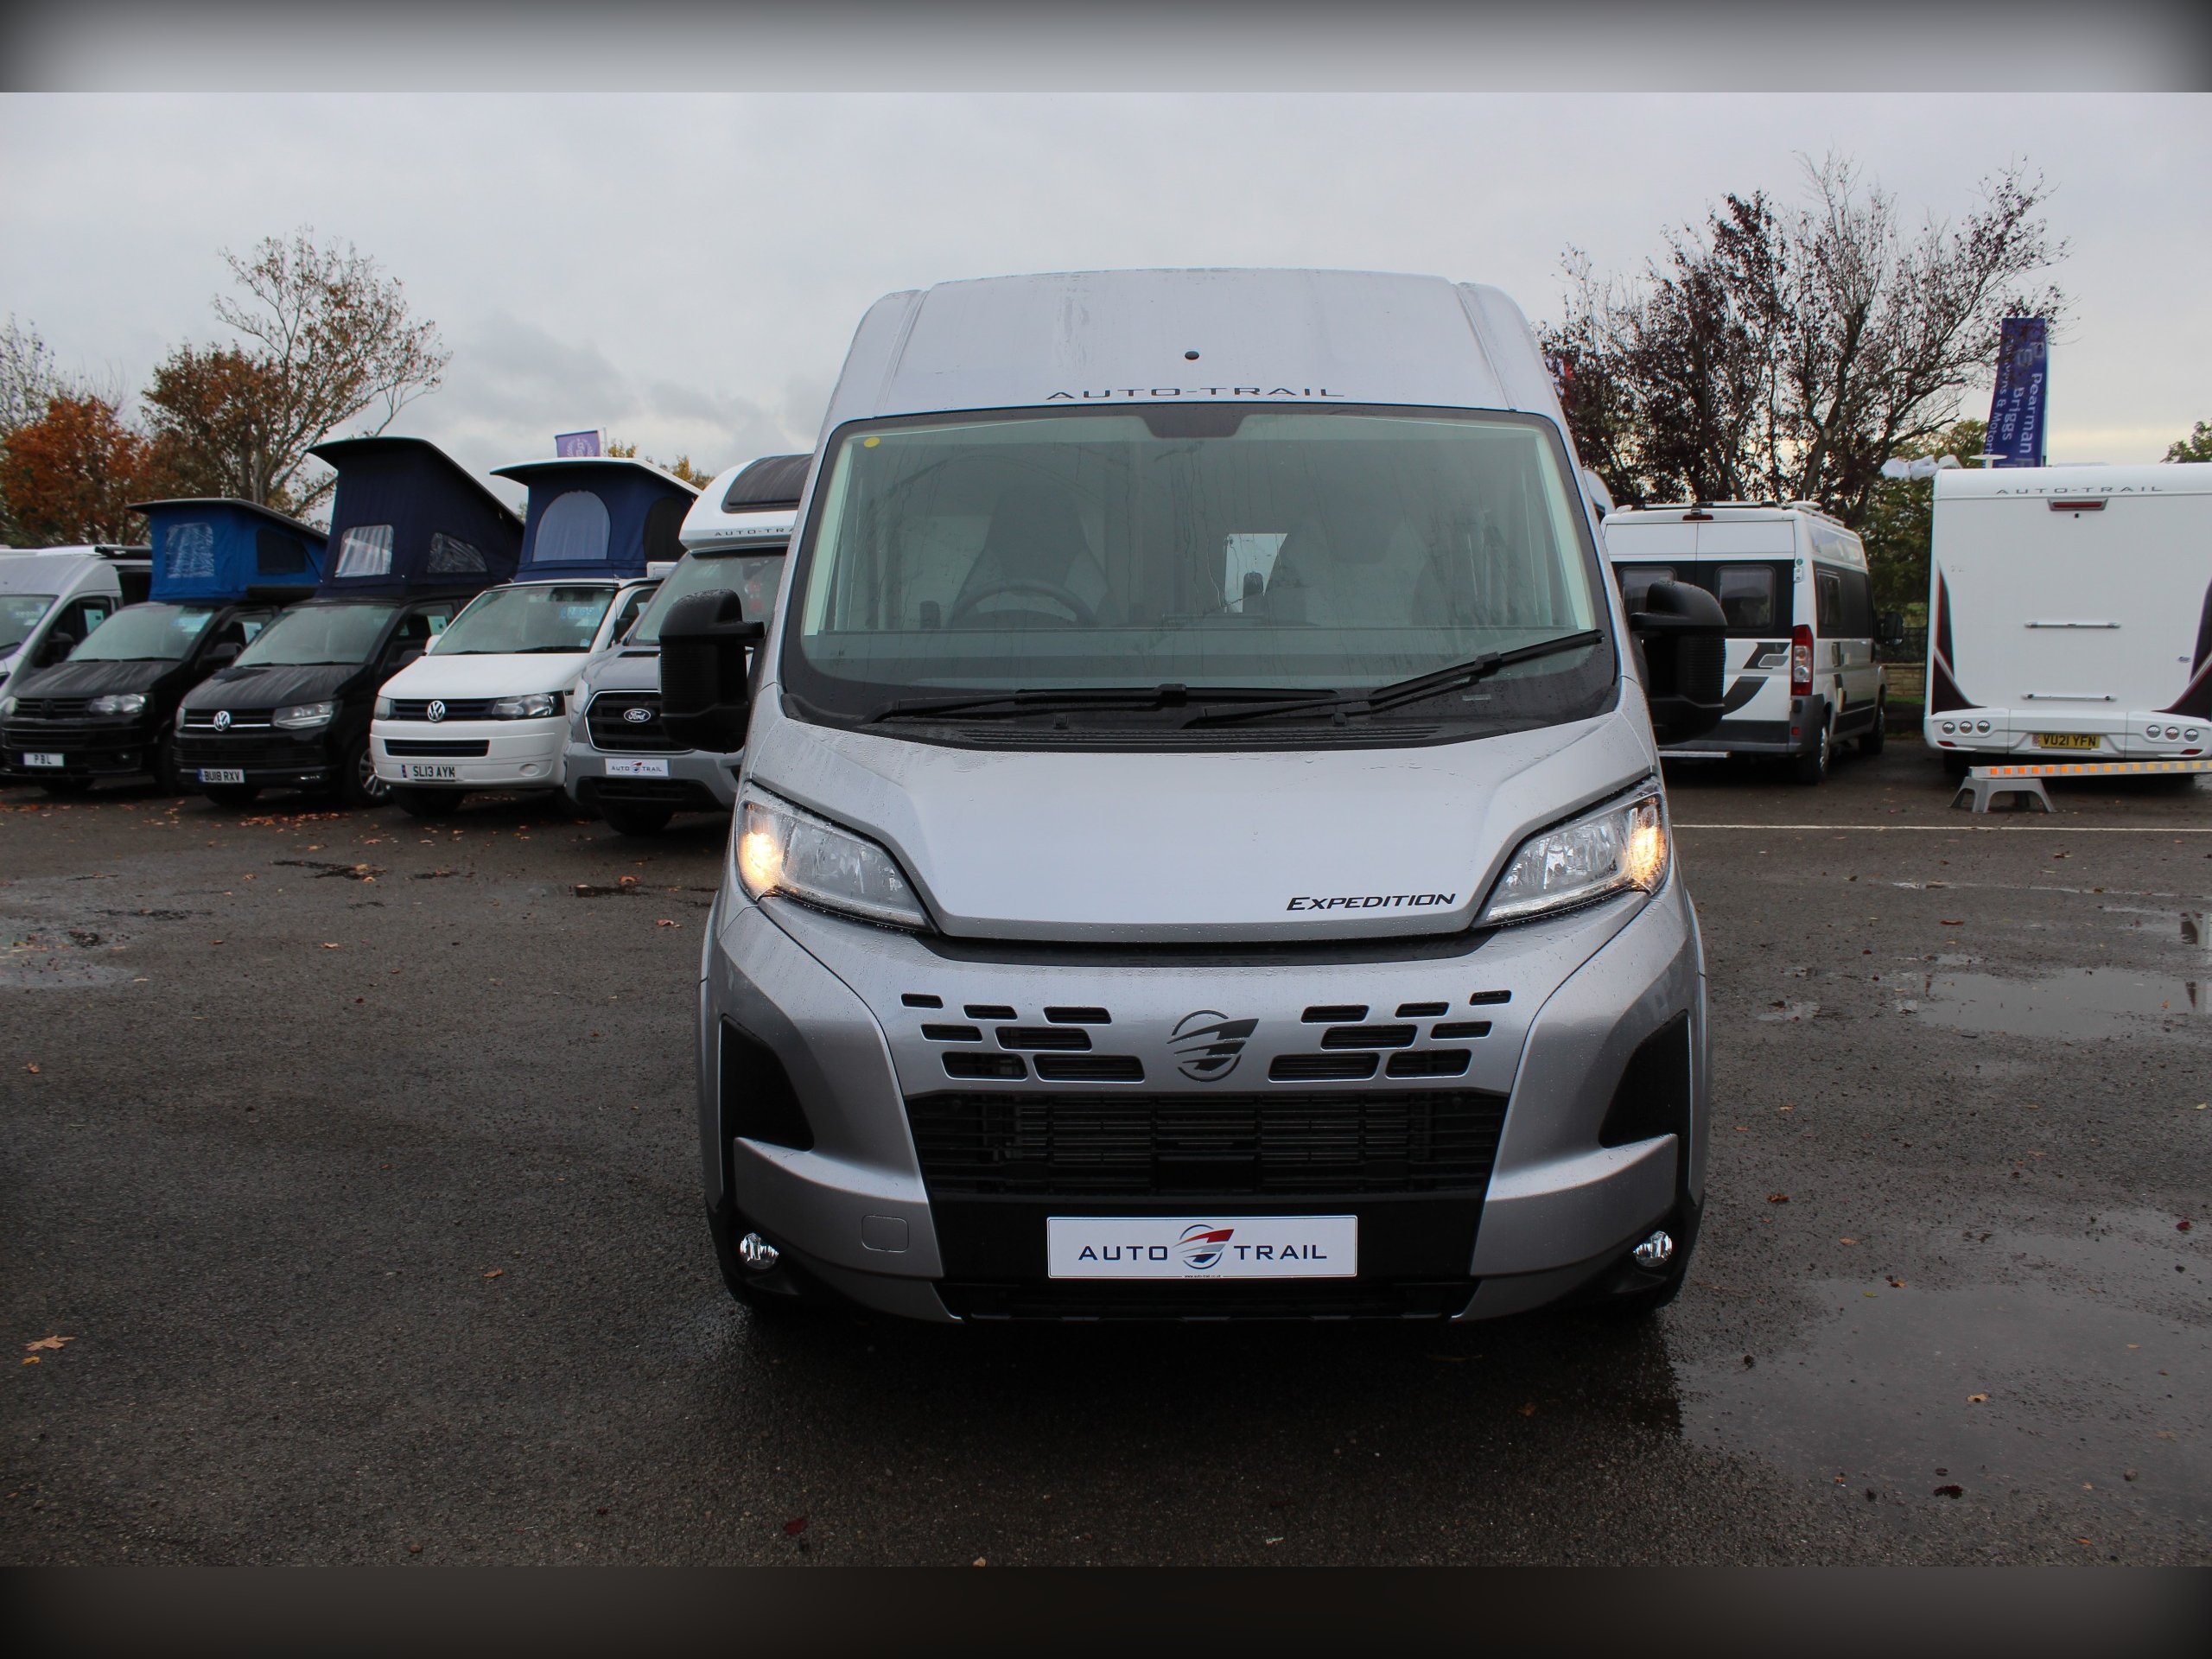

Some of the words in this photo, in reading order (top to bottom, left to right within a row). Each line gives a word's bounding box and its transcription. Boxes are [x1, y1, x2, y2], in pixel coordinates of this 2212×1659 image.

[1046, 387, 1345, 400] AUTO-TRAIL
[1996, 398, 2007, 409] &
[2001, 387, 2024, 441] Briggs
[2019, 372, 2044, 454] Pearman
[1996, 486, 2164, 495] AUTO-TRAIL
[628, 710, 646, 721] Ford
[2043, 734, 2069, 746] VU21
[2073, 735, 2096, 747] YFN
[223, 771, 240, 781] RXV
[413, 766, 434, 777] SL13
[1286, 893, 1456, 912] EXPEDITION
[1078, 1245, 1168, 1261] AUTO
[1233, 1244, 1328, 1260] TRAIL
